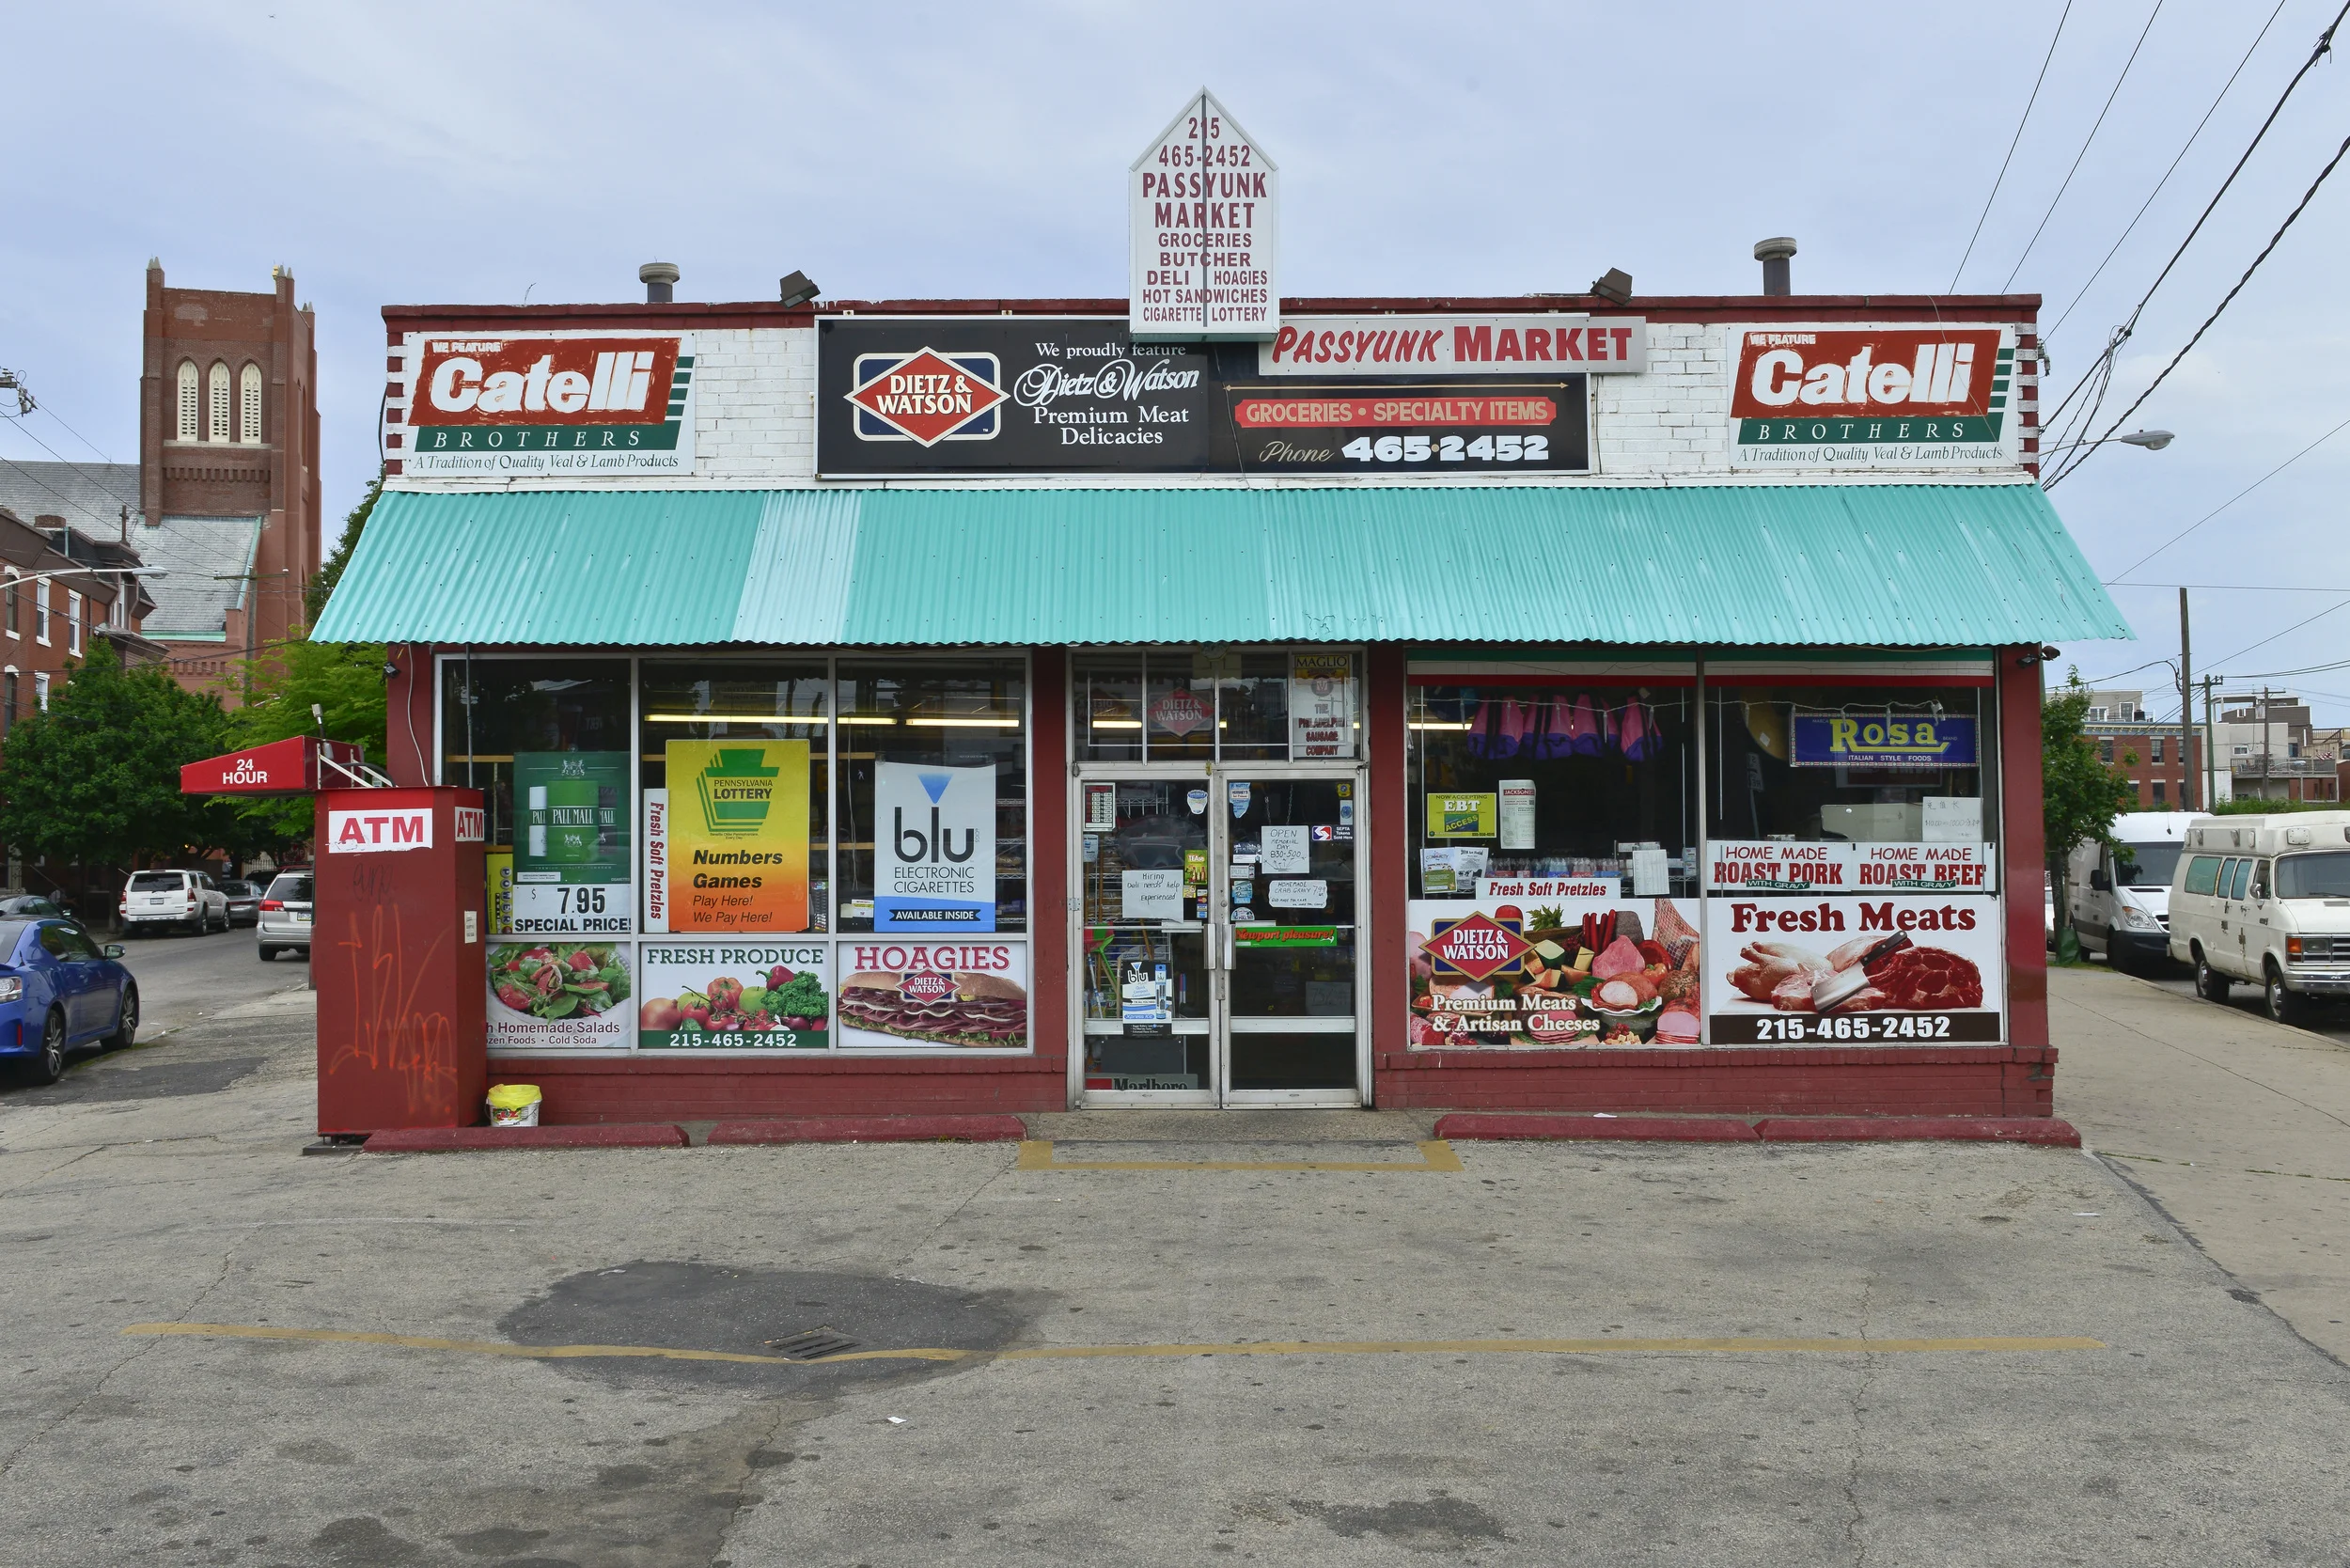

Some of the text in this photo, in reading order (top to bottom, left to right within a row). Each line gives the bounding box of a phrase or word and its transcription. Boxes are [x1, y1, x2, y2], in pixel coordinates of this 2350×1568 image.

[1188, 118, 1220, 139] 215
[1159, 145, 1251, 167] 465-2452
[1142, 172, 1267, 198] PASSYUNK
[1154, 202, 1255, 228] MARKET
[1158, 232, 1252, 248] GROCERIES
[1160, 252, 1251, 267] BUTCHER
[1147, 270, 1268, 286] DELI HOAGIES
[1142, 289, 1268, 304] HOT SANDWICHES
[1143, 306, 1267, 321] CIGARETTE LOTTERY
[432, 341, 501, 353] WE FEATURE
[1272, 325, 1633, 365] PASSYUNK MARKET
[1749, 334, 1816, 346] WE FEATURE
[1035, 341, 1186, 358] We proudly feature
[430, 351, 656, 414] Catelli
[1750, 343, 1976, 406] Catelli
[889, 374, 974, 396] DIETZ &
[1013, 364, 1095, 407] Dietz
[1119, 359, 1200, 401] Watson
[876, 394, 973, 416] WATSON
[1246, 401, 1548, 423] GROCERIES SPECIALTY ITEMS
[1033, 406, 1190, 425] Premium Meat
[433, 430, 641, 448] BROTHERS
[1060, 427, 1165, 446] Delicacies
[1758, 422, 1964, 441] BROTHERS
[1259, 440, 1335, 463] Phone
[1737, 445, 2003, 463] A Tradition of Quality Veal & Lamb Products
[414, 453, 679, 471] A Tradition of Quality Veal & Lamb Products
[1296, 656, 1347, 667] MAGLIO
[1162, 698, 1201, 711] DIETZ &
[1314, 703, 1329, 714] THE
[1155, 710, 1202, 722] WATSON
[1306, 730, 1339, 742] SAUSAGE
[1829, 718, 1938, 752] Rosa
[1306, 745, 1340, 756] COMPANY
[236, 759, 254, 772] 24
[222, 771, 268, 785] HOUR
[713, 788, 773, 800] LOTTERY
[1444, 800, 1480, 812] EBT
[457, 810, 484, 839] ATM
[553, 809, 594, 824] PALL MALL
[1446, 815, 1478, 832] ACCESS
[338, 815, 424, 844] ATM
[894, 807, 975, 863] blu
[1270, 829, 1297, 838] OPEN
[650, 802, 665, 919] Fresh Soft Pretzles
[693, 849, 783, 865] Numbers
[1726, 846, 1827, 861] HOME MADE
[1871, 847, 1972, 861] HOME MADE
[693, 873, 762, 888] Games
[894, 867, 975, 879] ELECTRONIC
[1142, 873, 1165, 885] Hiring
[1714, 862, 1843, 885] ROAST PORK
[1859, 863, 1987, 886] ROAST BEEF
[894, 881, 975, 893] CIGARETTES
[1167, 881, 1180, 892] help
[1489, 882, 1606, 897] Fresh Soft Pretzles
[1747, 880, 1809, 889] WITH GRAVY
[1893, 880, 1953, 889] WITH GRAVY
[556, 887, 605, 915] 7.95
[693, 895, 754, 909] Play Here!
[693, 911, 773, 925] We Pay Here!
[896, 911, 975, 919] AVAILABLE INSIDE
[1730, 902, 1977, 933] Fresh Meats
[514, 917, 632, 933] SPECIAL PRICE!
[1235, 929, 1334, 942] Newport pleasure!
[1453, 929, 1507, 945] DIETZ &
[647, 948, 823, 965] FRESH PRODUCE
[854, 946, 1010, 971] HOAGIES
[1442, 944, 1510, 961] WATSON
[914, 977, 946, 986] DIETZ &
[1128, 970, 1149, 983] blu
[908, 984, 946, 994] WATSON
[1431, 994, 1576, 1012] Premium Meats
[497, 1021, 573, 1034] Homemade
[576, 1021, 620, 1034] Salads
[1432, 1013, 1600, 1032] & Artisan Cheeses
[1756, 1016, 1950, 1041] 215-465-2452
[508, 1035, 597, 1044] Foods Cold Soda
[669, 1033, 797, 1047] 215-465-2452
[1114, 1078, 1188, 1090] Marlboro
